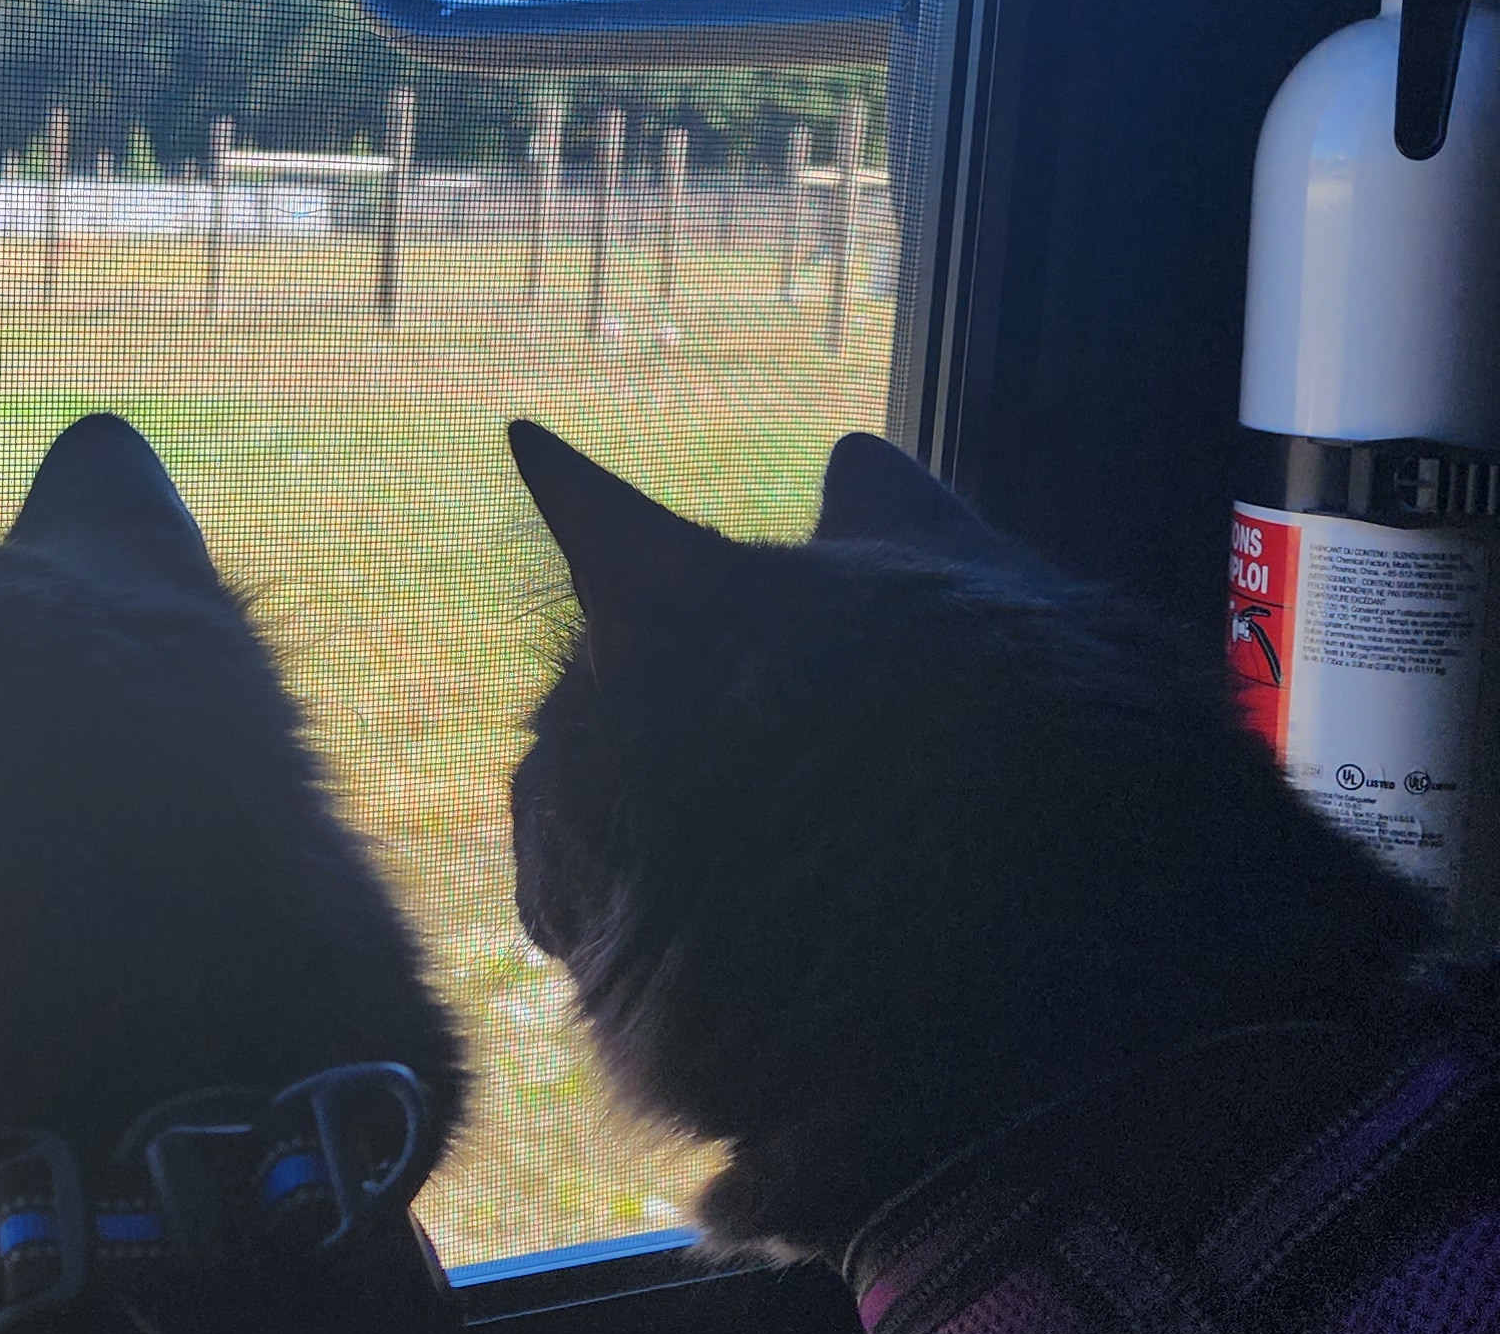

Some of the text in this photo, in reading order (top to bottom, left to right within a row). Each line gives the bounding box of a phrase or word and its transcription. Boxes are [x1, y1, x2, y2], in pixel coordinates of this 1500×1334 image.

[1232, 521, 1263, 558] ONS
[1342, 769, 1358, 786] UL
[1366, 779, 1396, 789] LISTED
